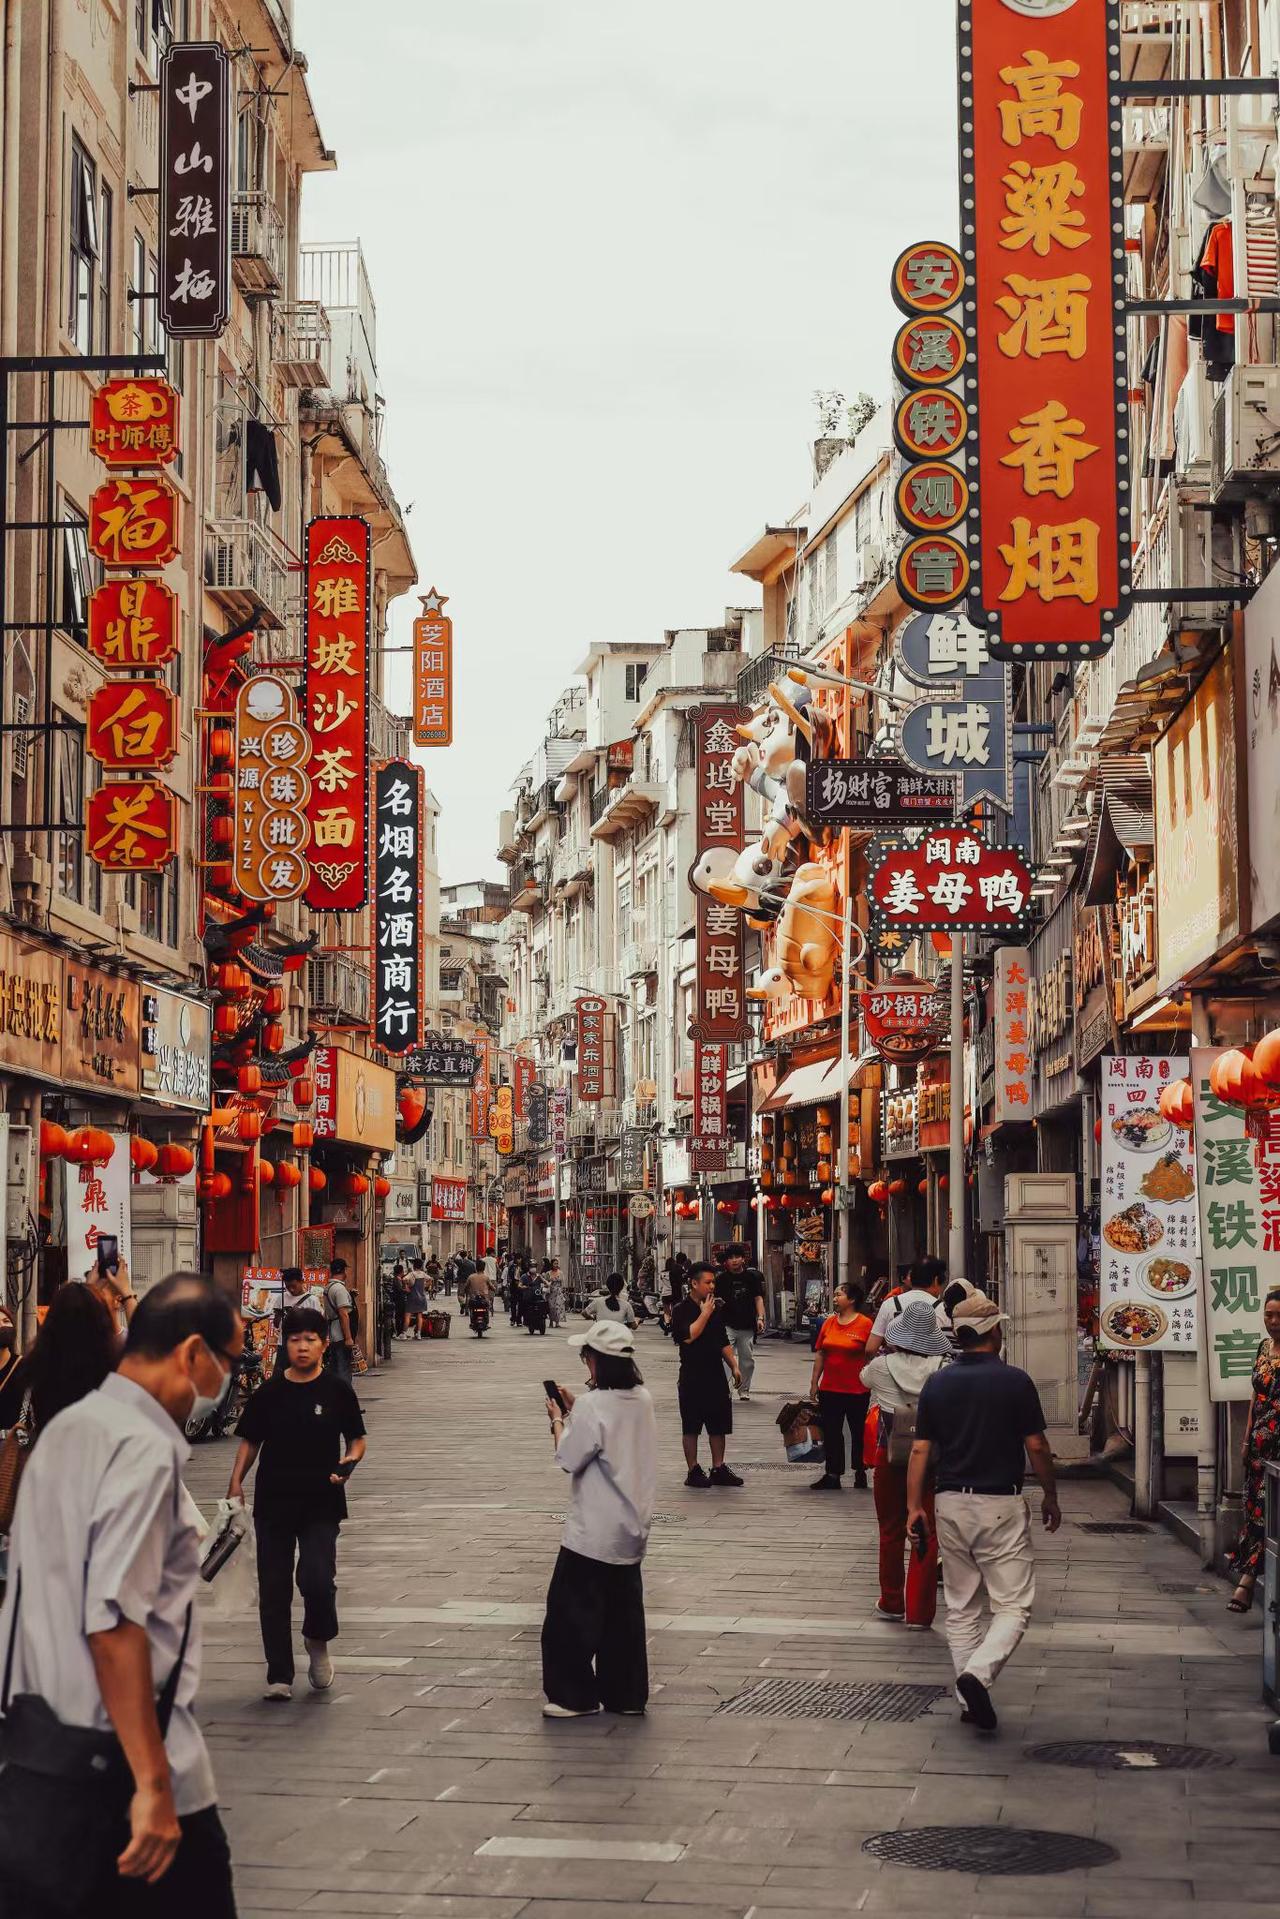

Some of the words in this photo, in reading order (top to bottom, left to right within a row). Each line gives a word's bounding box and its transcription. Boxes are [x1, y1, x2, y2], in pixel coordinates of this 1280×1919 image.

[170, 72, 217, 304] 中山雅栖
[997, 50, 1100, 603] 高粱酒香烟
[119, 393, 143, 418] 茶
[907, 254, 958, 593] 安溪铁观音
[95, 424, 174, 451] 叶师傅
[420, 624, 445, 726] 芝阳酒店
[311, 577, 362, 848] 雅坡沙茶面
[269, 731, 298, 890] 珍珠批发
[819, 768, 893, 813] 杨财富
[926, 836, 981, 865] 闽南
[378, 779, 416, 1036] 名烟名酒商行
[882, 869, 1024, 914] 姜母鸭
[706, 904, 740, 1020] 姜母鸭
[870, 994, 943, 1018] 砂锅粥
[406, 1056, 475, 1074] 茶农直销
[583, 1015, 600, 1095] 家家乐酒店
[1109, 1057, 1154, 1079] 闽南
[1166, 1214, 1176, 1248] 绵绵冰
[1179, 1214, 1188, 1248] 奥利奥
[1108, 1259, 1119, 1293] 大满贯
[1171, 1308, 1182, 1343] 大满贯
[1183, 1307, 1195, 1342] 烧仙草
